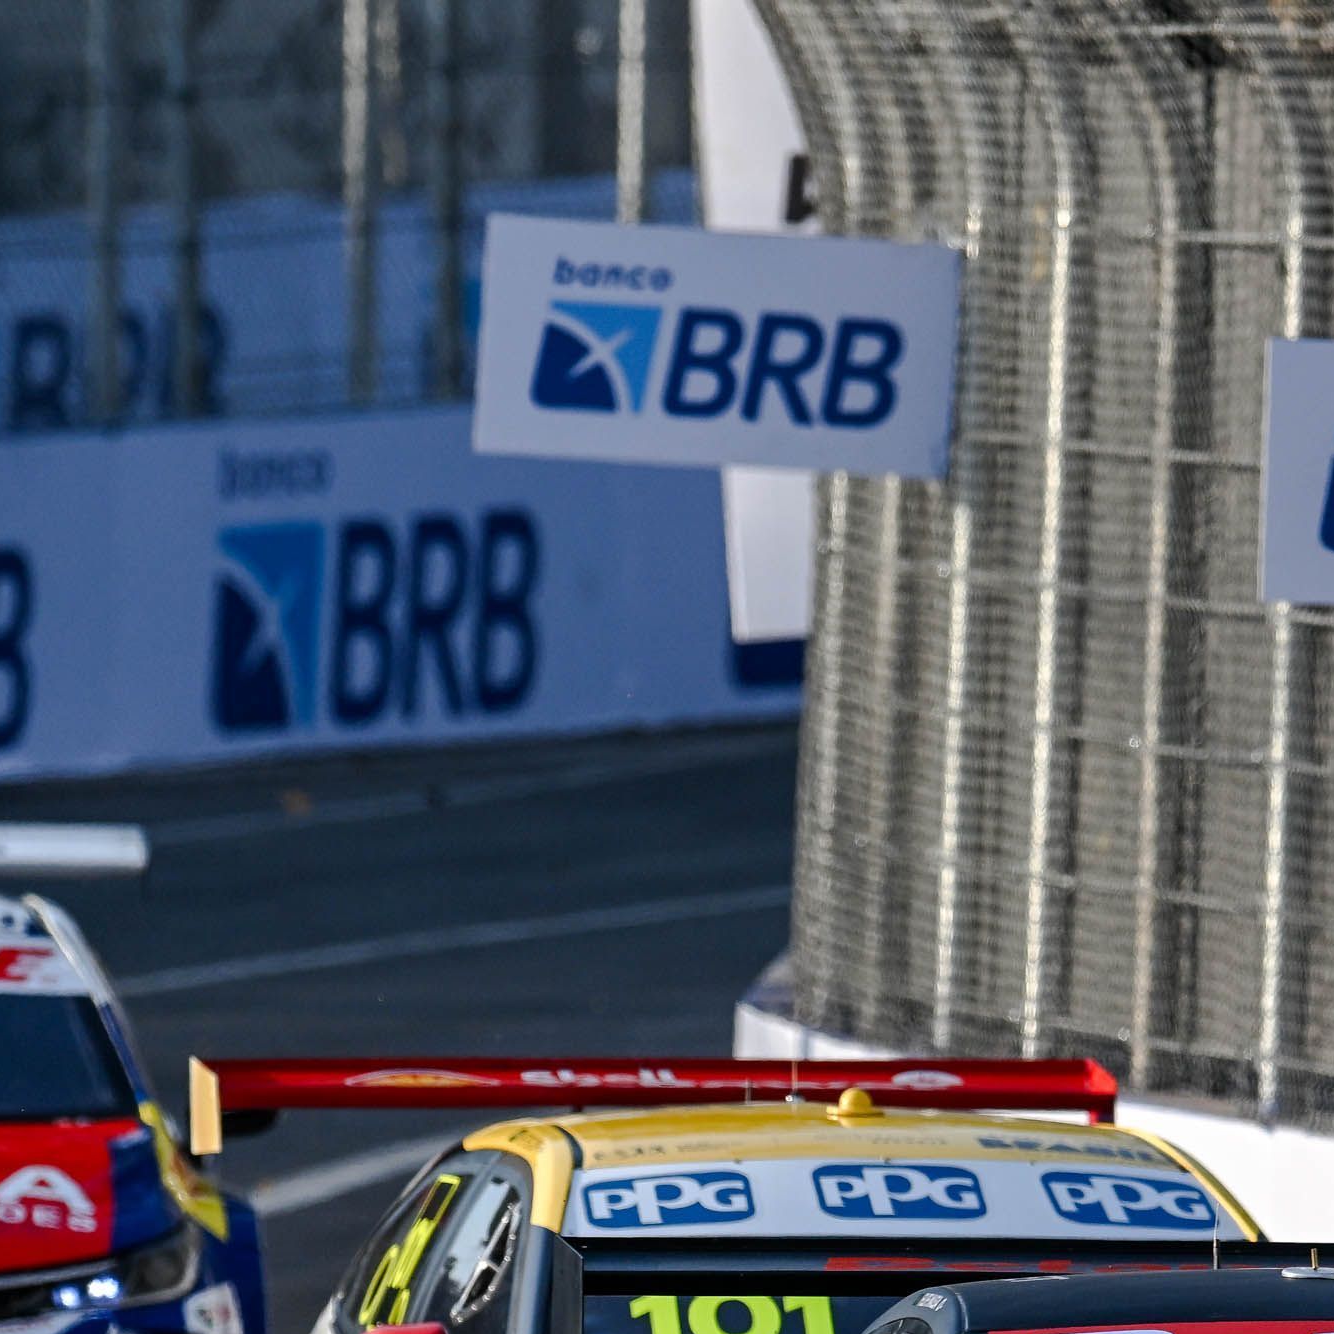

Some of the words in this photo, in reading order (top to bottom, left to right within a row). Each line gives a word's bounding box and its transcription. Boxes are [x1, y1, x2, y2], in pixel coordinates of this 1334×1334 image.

[553, 256, 675, 292] banco
[662, 305, 906, 430] BRB
[330, 507, 541, 729] BRB
[520, 1068, 697, 1089] Shell
[588, 1175, 747, 1226] PPG
[819, 1165, 980, 1217] PPG
[1048, 1174, 1210, 1224] PPG
